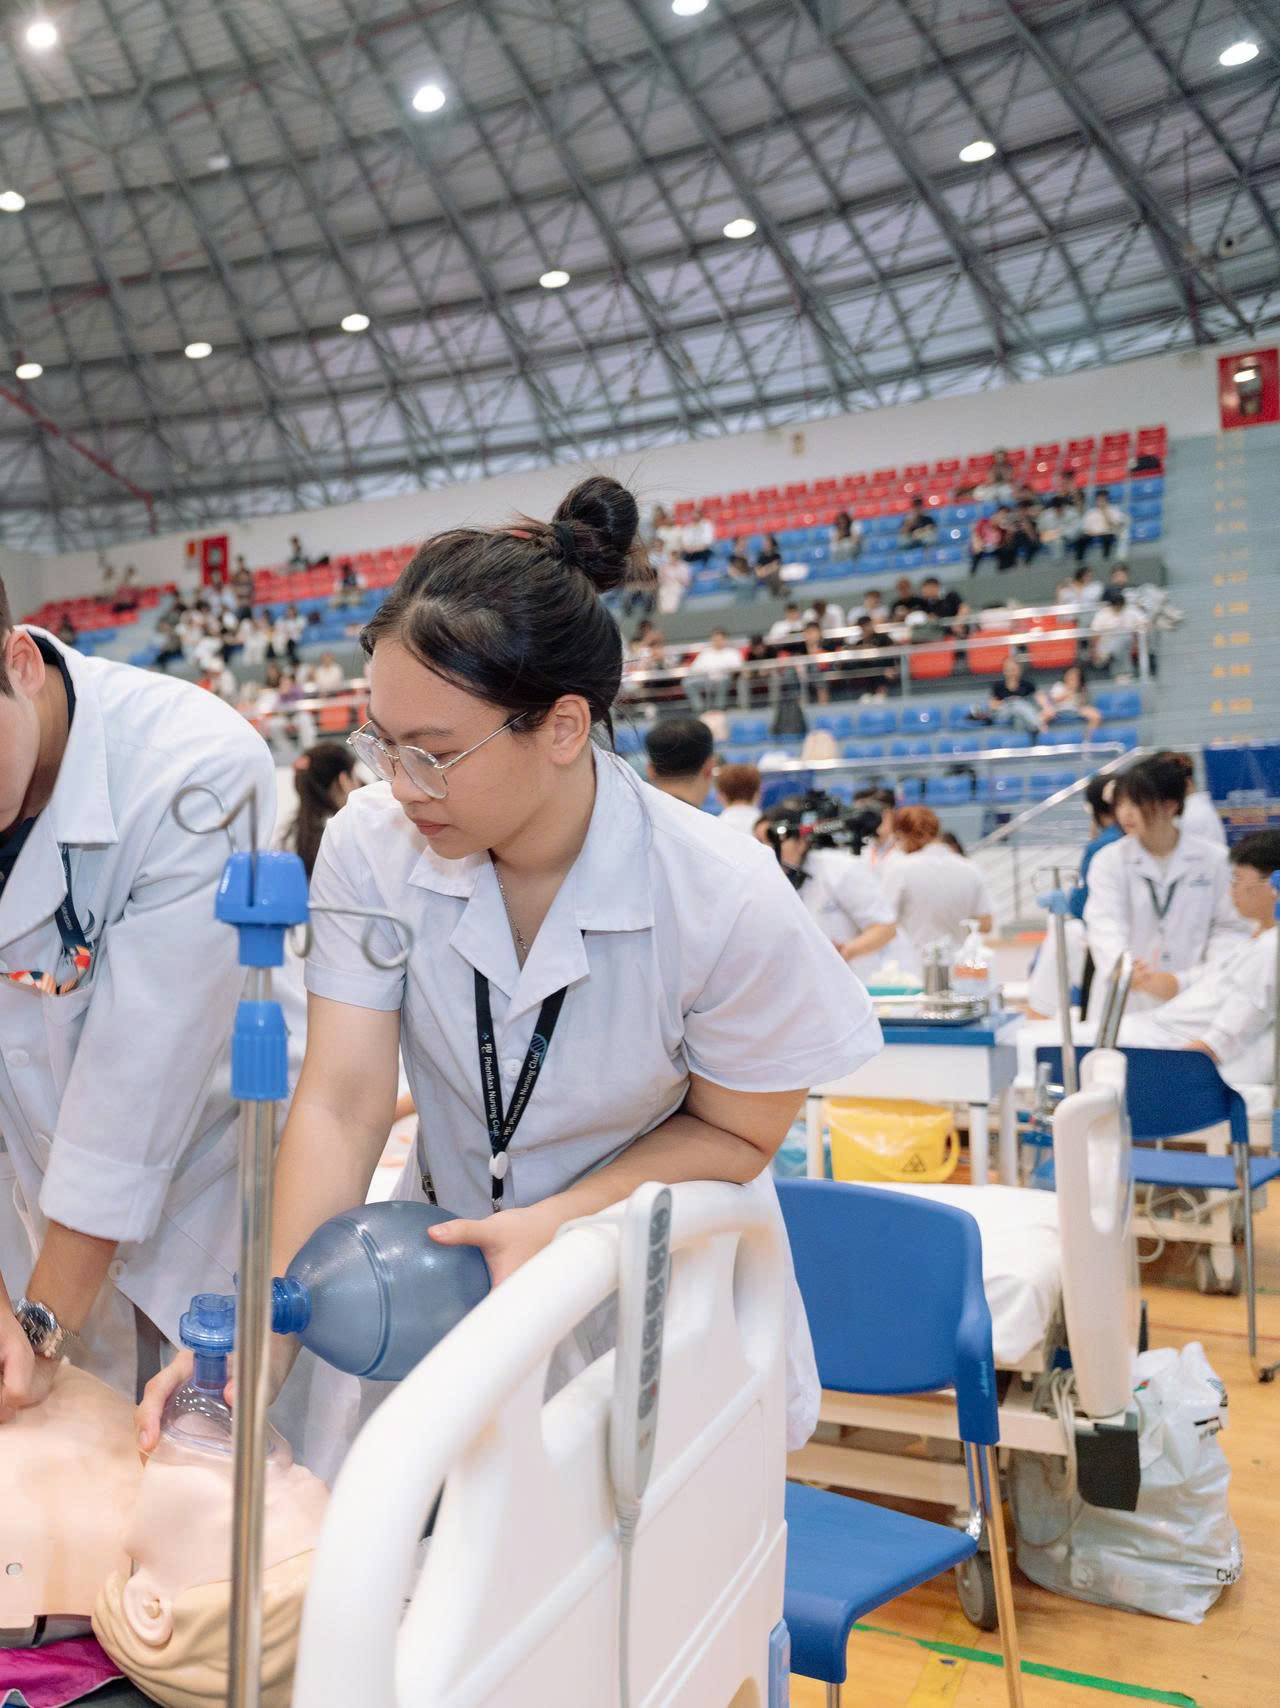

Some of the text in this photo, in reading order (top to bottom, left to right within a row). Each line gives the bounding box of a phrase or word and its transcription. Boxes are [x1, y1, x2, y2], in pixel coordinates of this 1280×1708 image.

[484, 1056, 494, 1090] Phenikaa
[520, 1070, 536, 1096] Nursing
[528, 1052, 540, 1069] Club
[488, 1090, 498, 1119] Nursing
